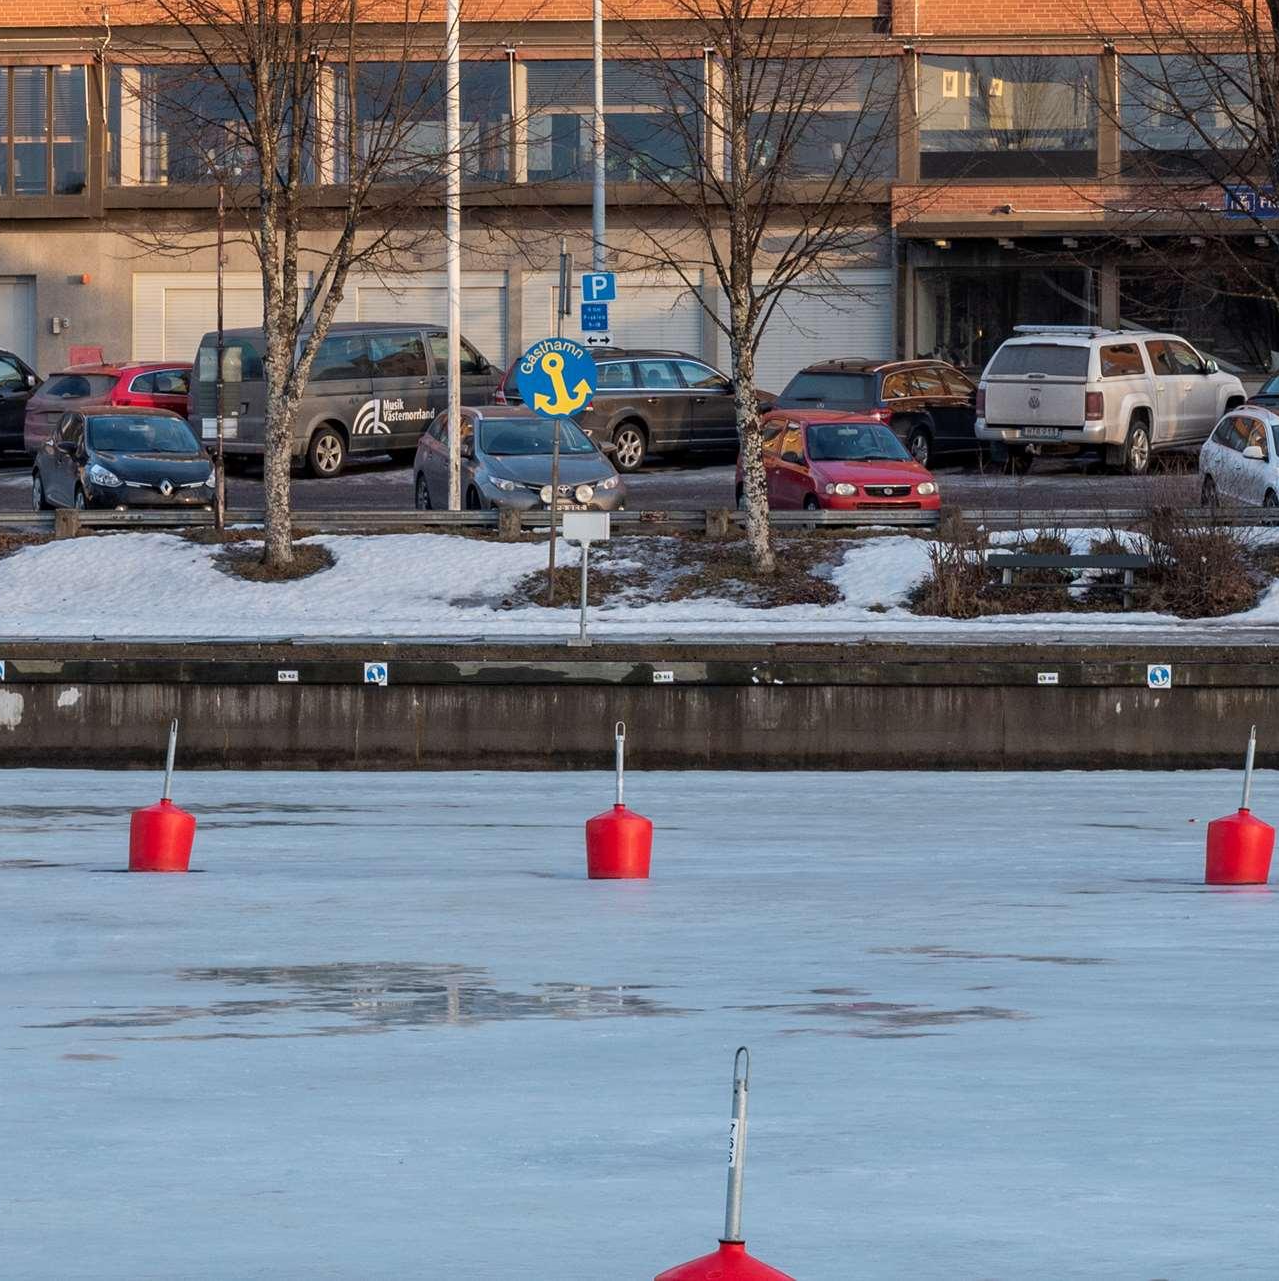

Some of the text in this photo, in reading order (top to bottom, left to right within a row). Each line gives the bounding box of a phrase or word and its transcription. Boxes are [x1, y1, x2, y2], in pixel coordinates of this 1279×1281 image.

[591, 275, 608, 299] P
[520, 340, 584, 374] Gästhamn
[383, 398, 405, 410] Musik
